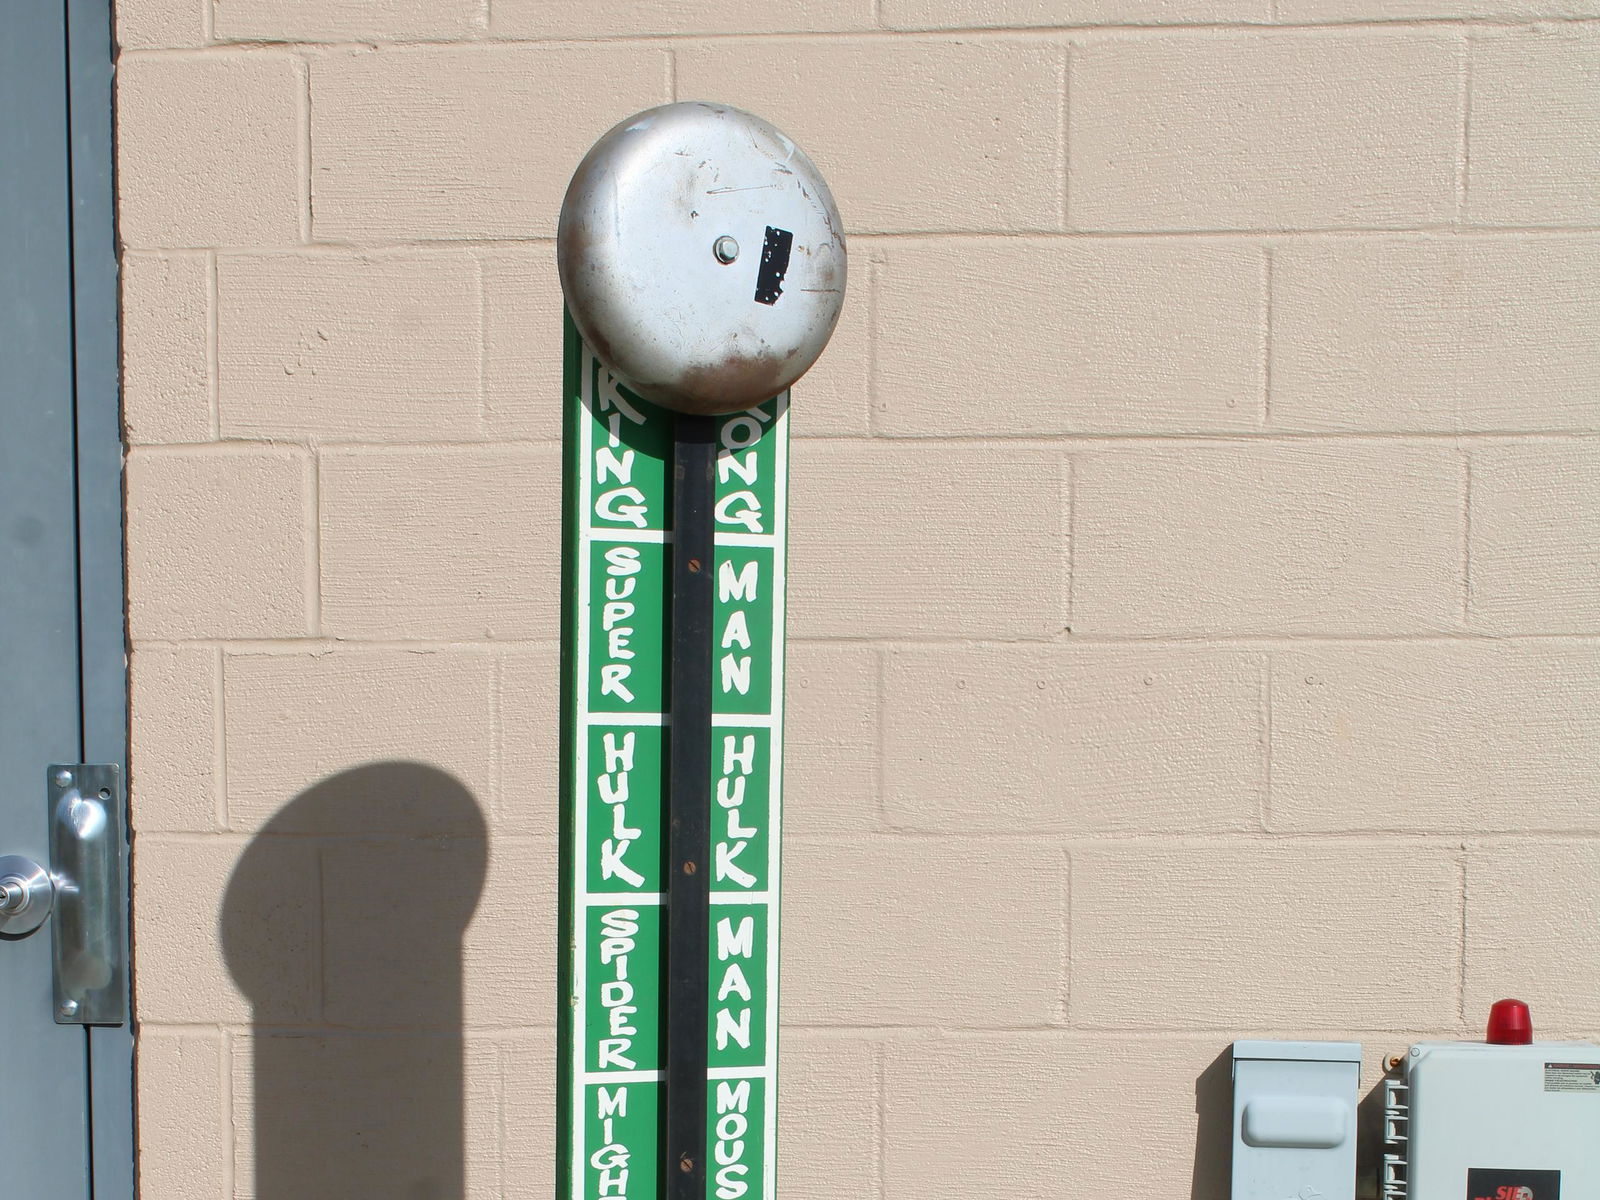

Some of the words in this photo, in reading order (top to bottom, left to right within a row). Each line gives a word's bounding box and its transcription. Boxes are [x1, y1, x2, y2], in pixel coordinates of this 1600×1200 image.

[594, 366, 648, 529] KING
[714, 406, 772, 534] ONG
[602, 546, 642, 703] SUPER
[718, 559, 759, 695] MAN
[597, 731, 646, 888] HULK
[715, 734, 758, 889] HULK
[598, 908, 639, 1070] SPIDER
[715, 916, 754, 1051] MAN
